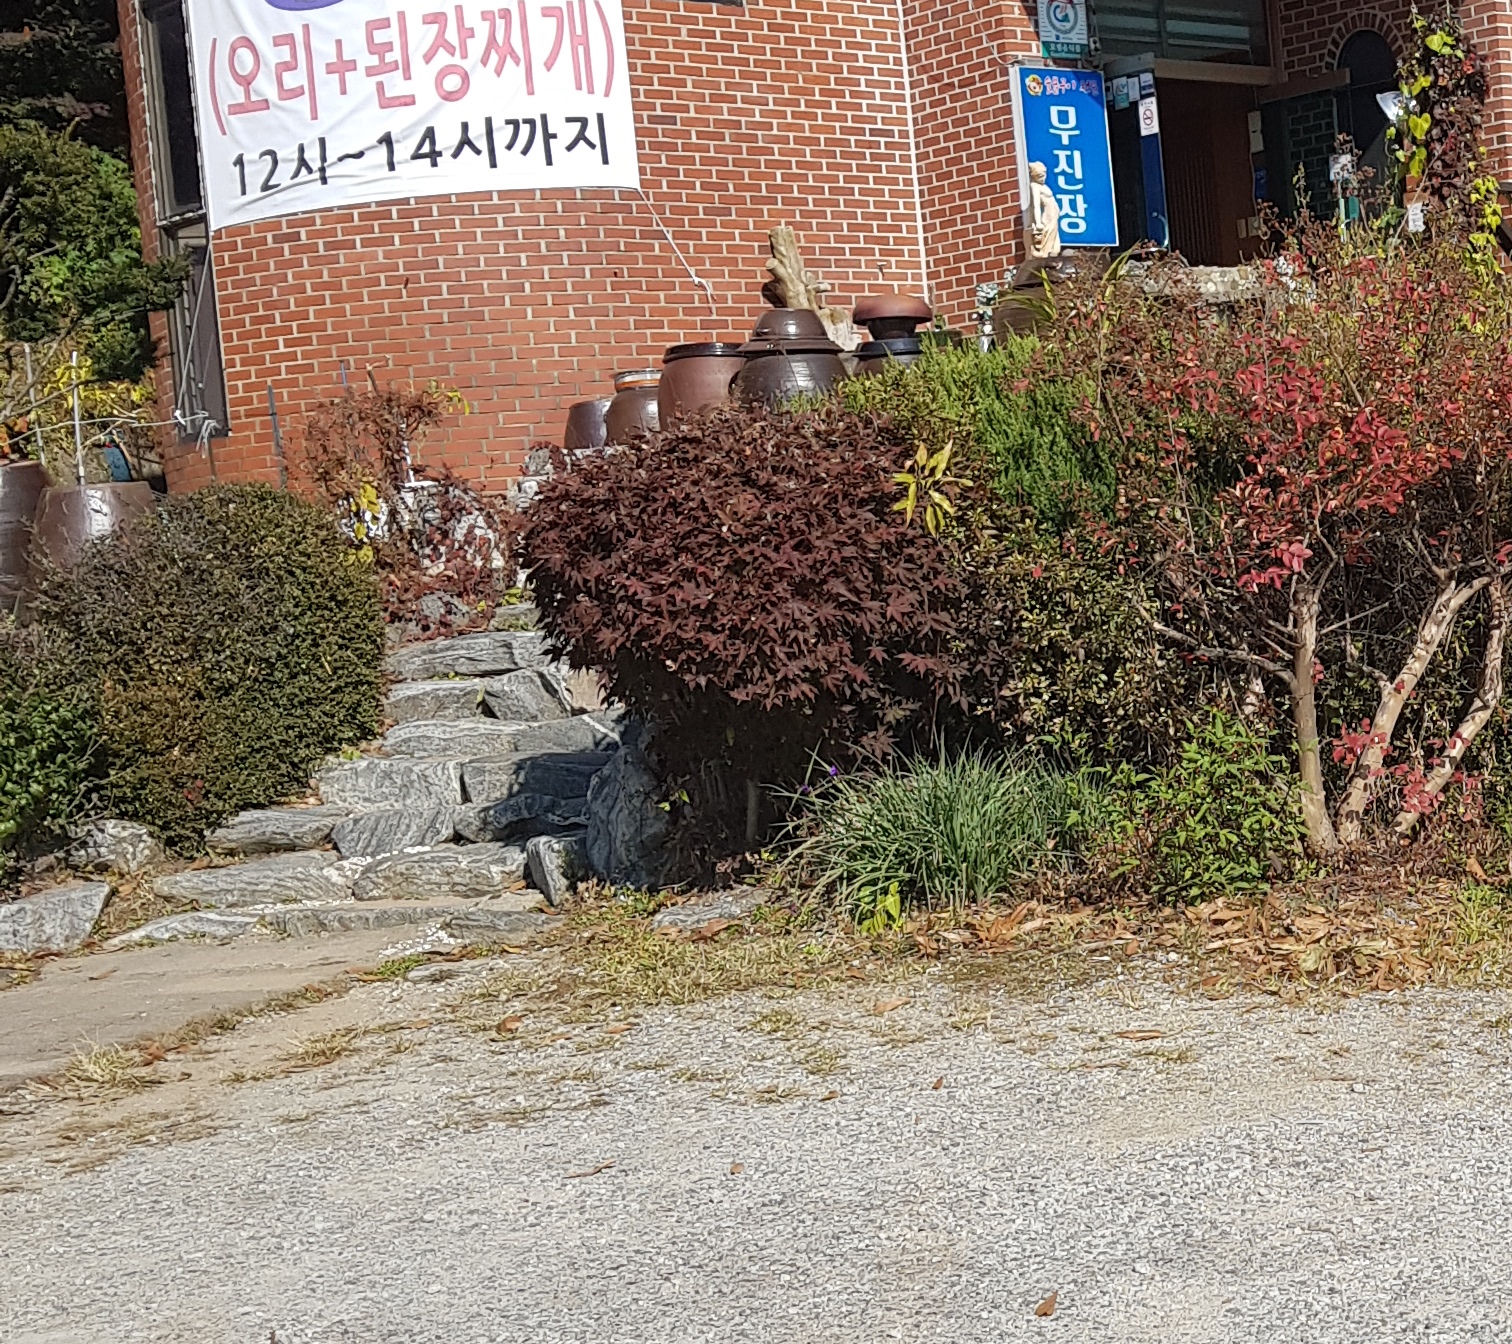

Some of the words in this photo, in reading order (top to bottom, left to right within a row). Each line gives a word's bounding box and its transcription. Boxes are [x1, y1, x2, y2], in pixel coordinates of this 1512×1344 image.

[208, 0, 615, 136] (오리+된장찌개)
[231, 112, 610, 196] 12시~14시까지
[1049, 106, 1088, 234] 무진장
